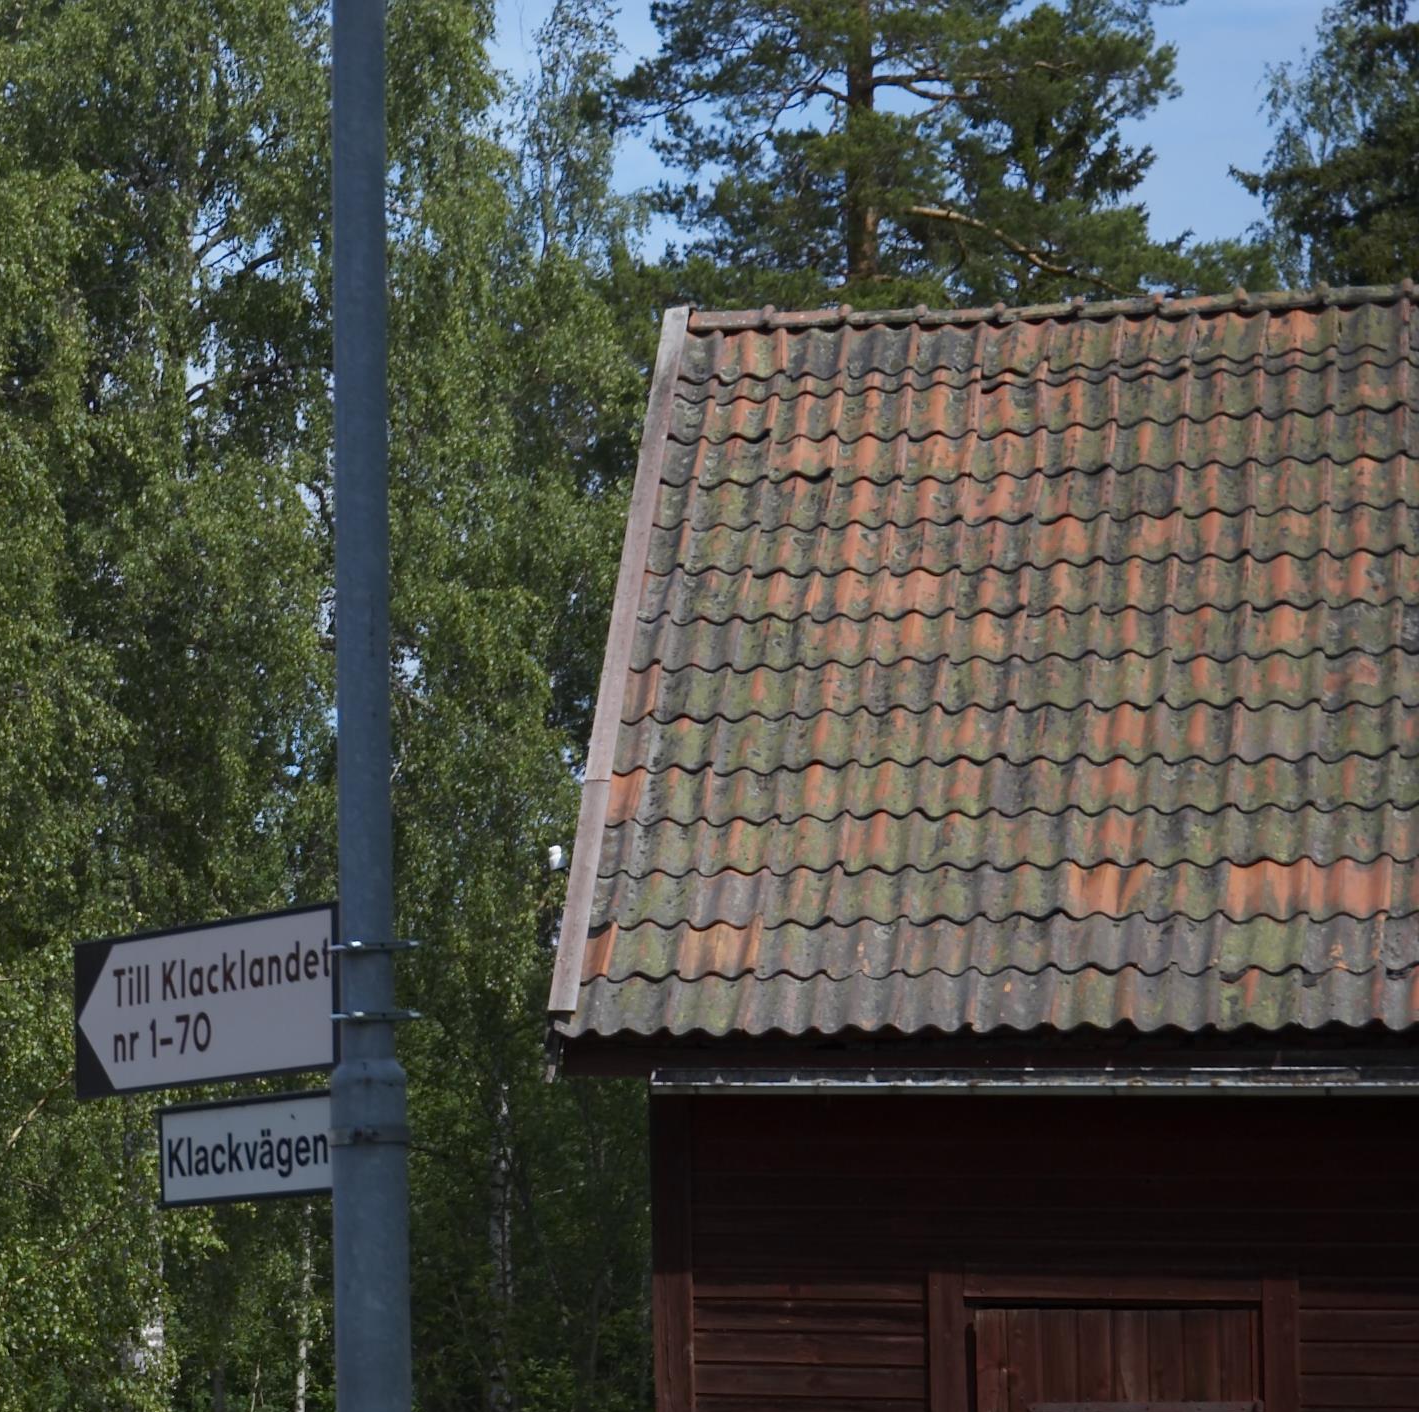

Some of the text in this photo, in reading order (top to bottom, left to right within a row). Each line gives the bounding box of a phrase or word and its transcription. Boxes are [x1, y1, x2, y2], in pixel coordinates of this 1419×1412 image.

[113, 938, 331, 1008] Till Klacklandet
[114, 1011, 212, 1063] nr 1-70
[167, 1128, 329, 1179] Klackvägen
